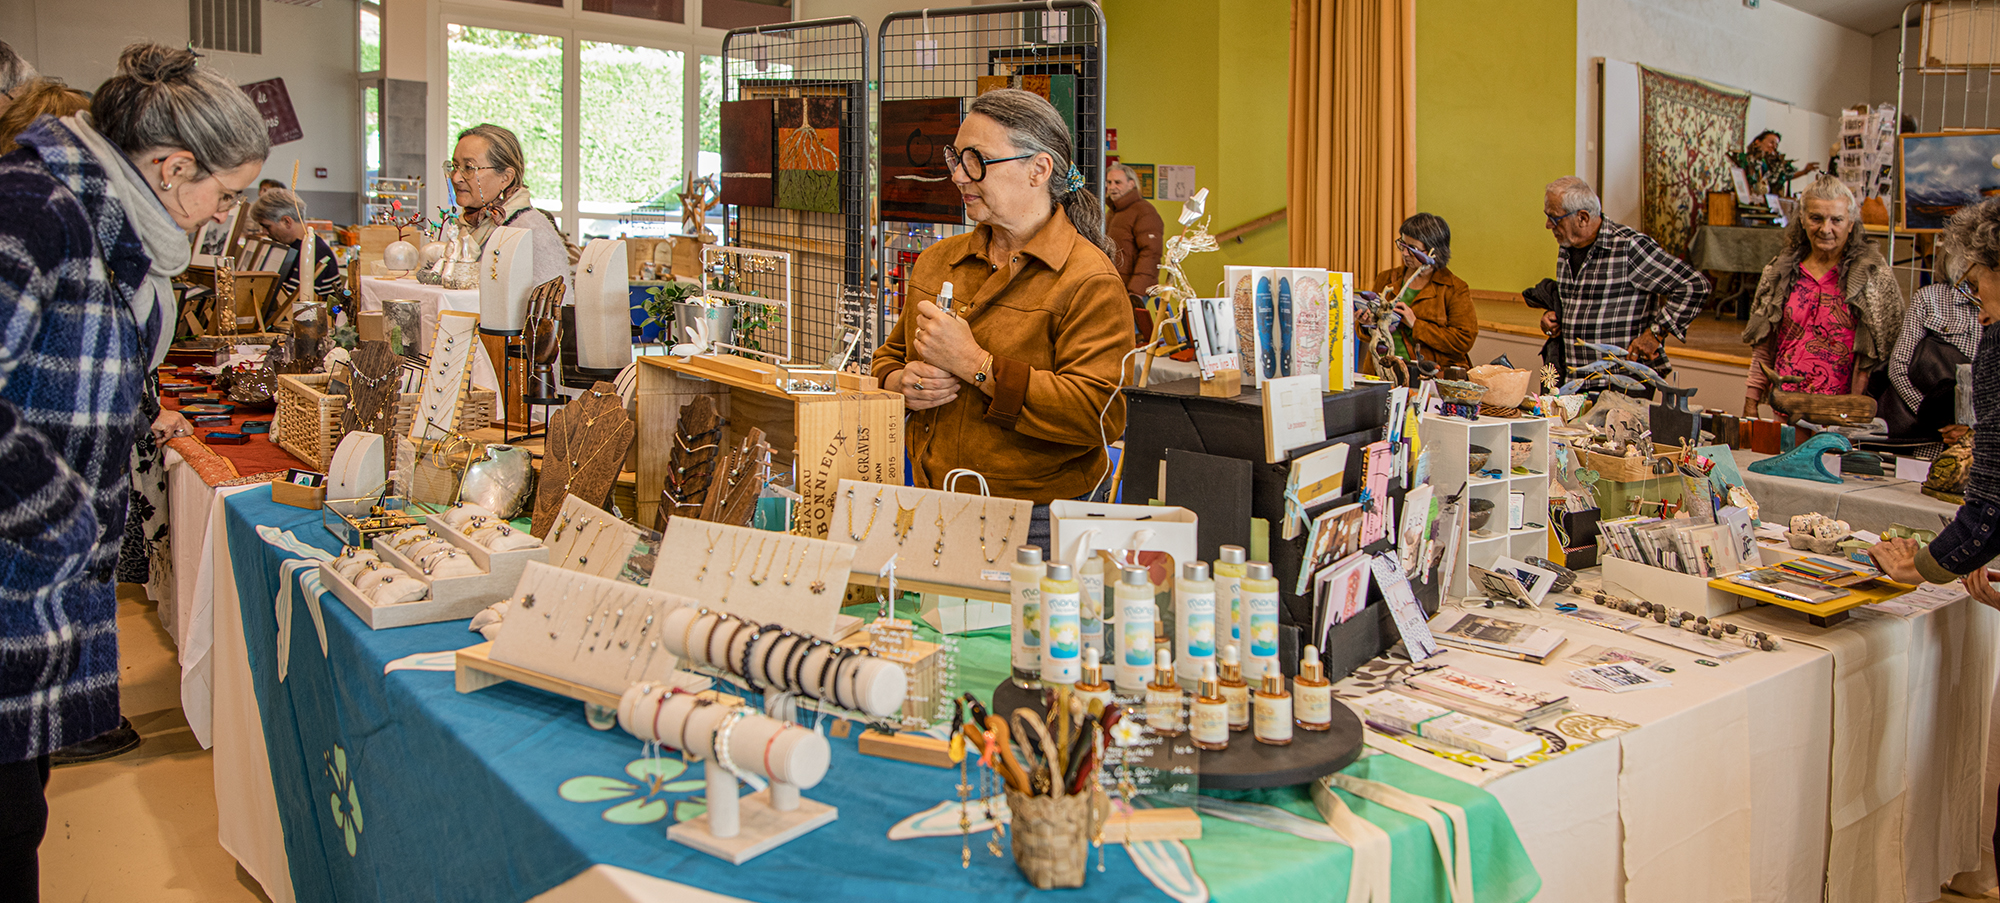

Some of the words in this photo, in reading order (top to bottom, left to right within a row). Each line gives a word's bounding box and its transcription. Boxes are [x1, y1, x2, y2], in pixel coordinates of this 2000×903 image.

[857, 427, 870, 474] GRAVES
[888, 456, 896, 478] 2015
[814, 430, 847, 536] BONNIEUX
